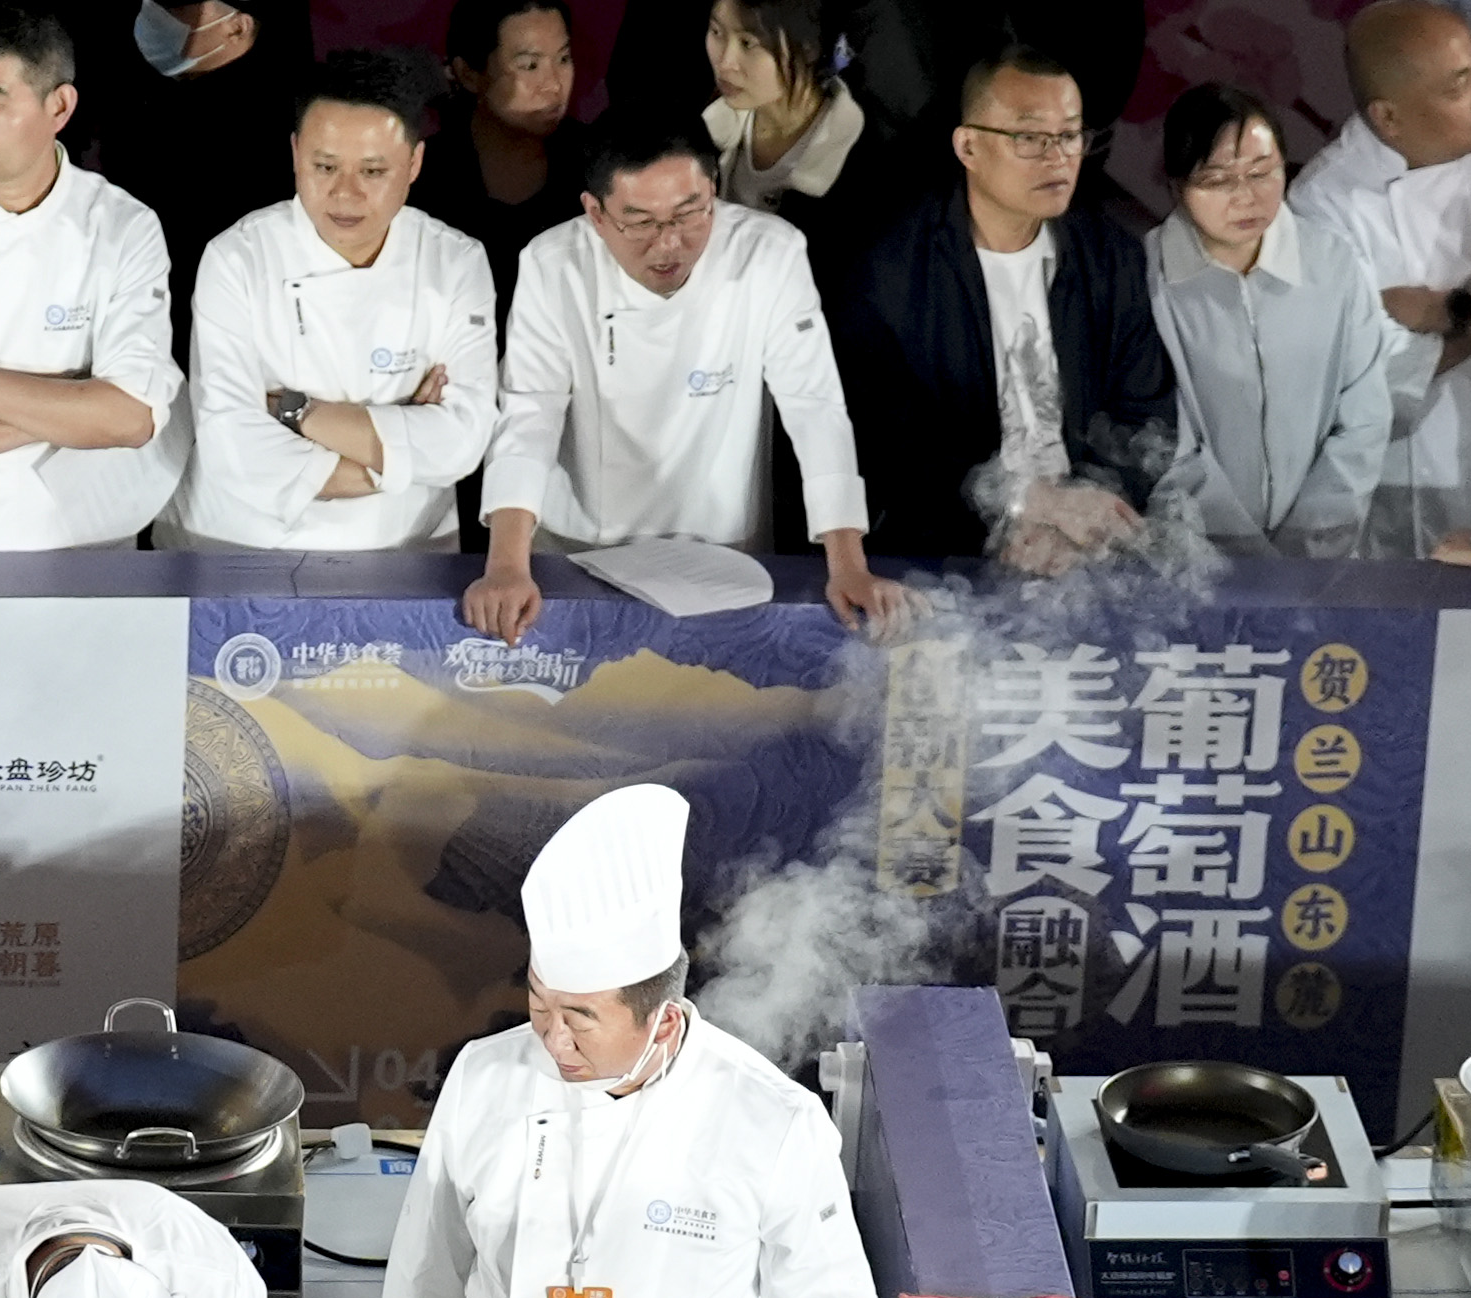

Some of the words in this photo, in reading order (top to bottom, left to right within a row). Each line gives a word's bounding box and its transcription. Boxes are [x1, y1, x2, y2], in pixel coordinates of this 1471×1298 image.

[967, 643, 1131, 897] 美食
[1106, 643, 1291, 1027] 葡萄酒
[1285, 651, 1355, 1017] 贺兰山东麓
[1000, 908, 1083, 1036] 融合
